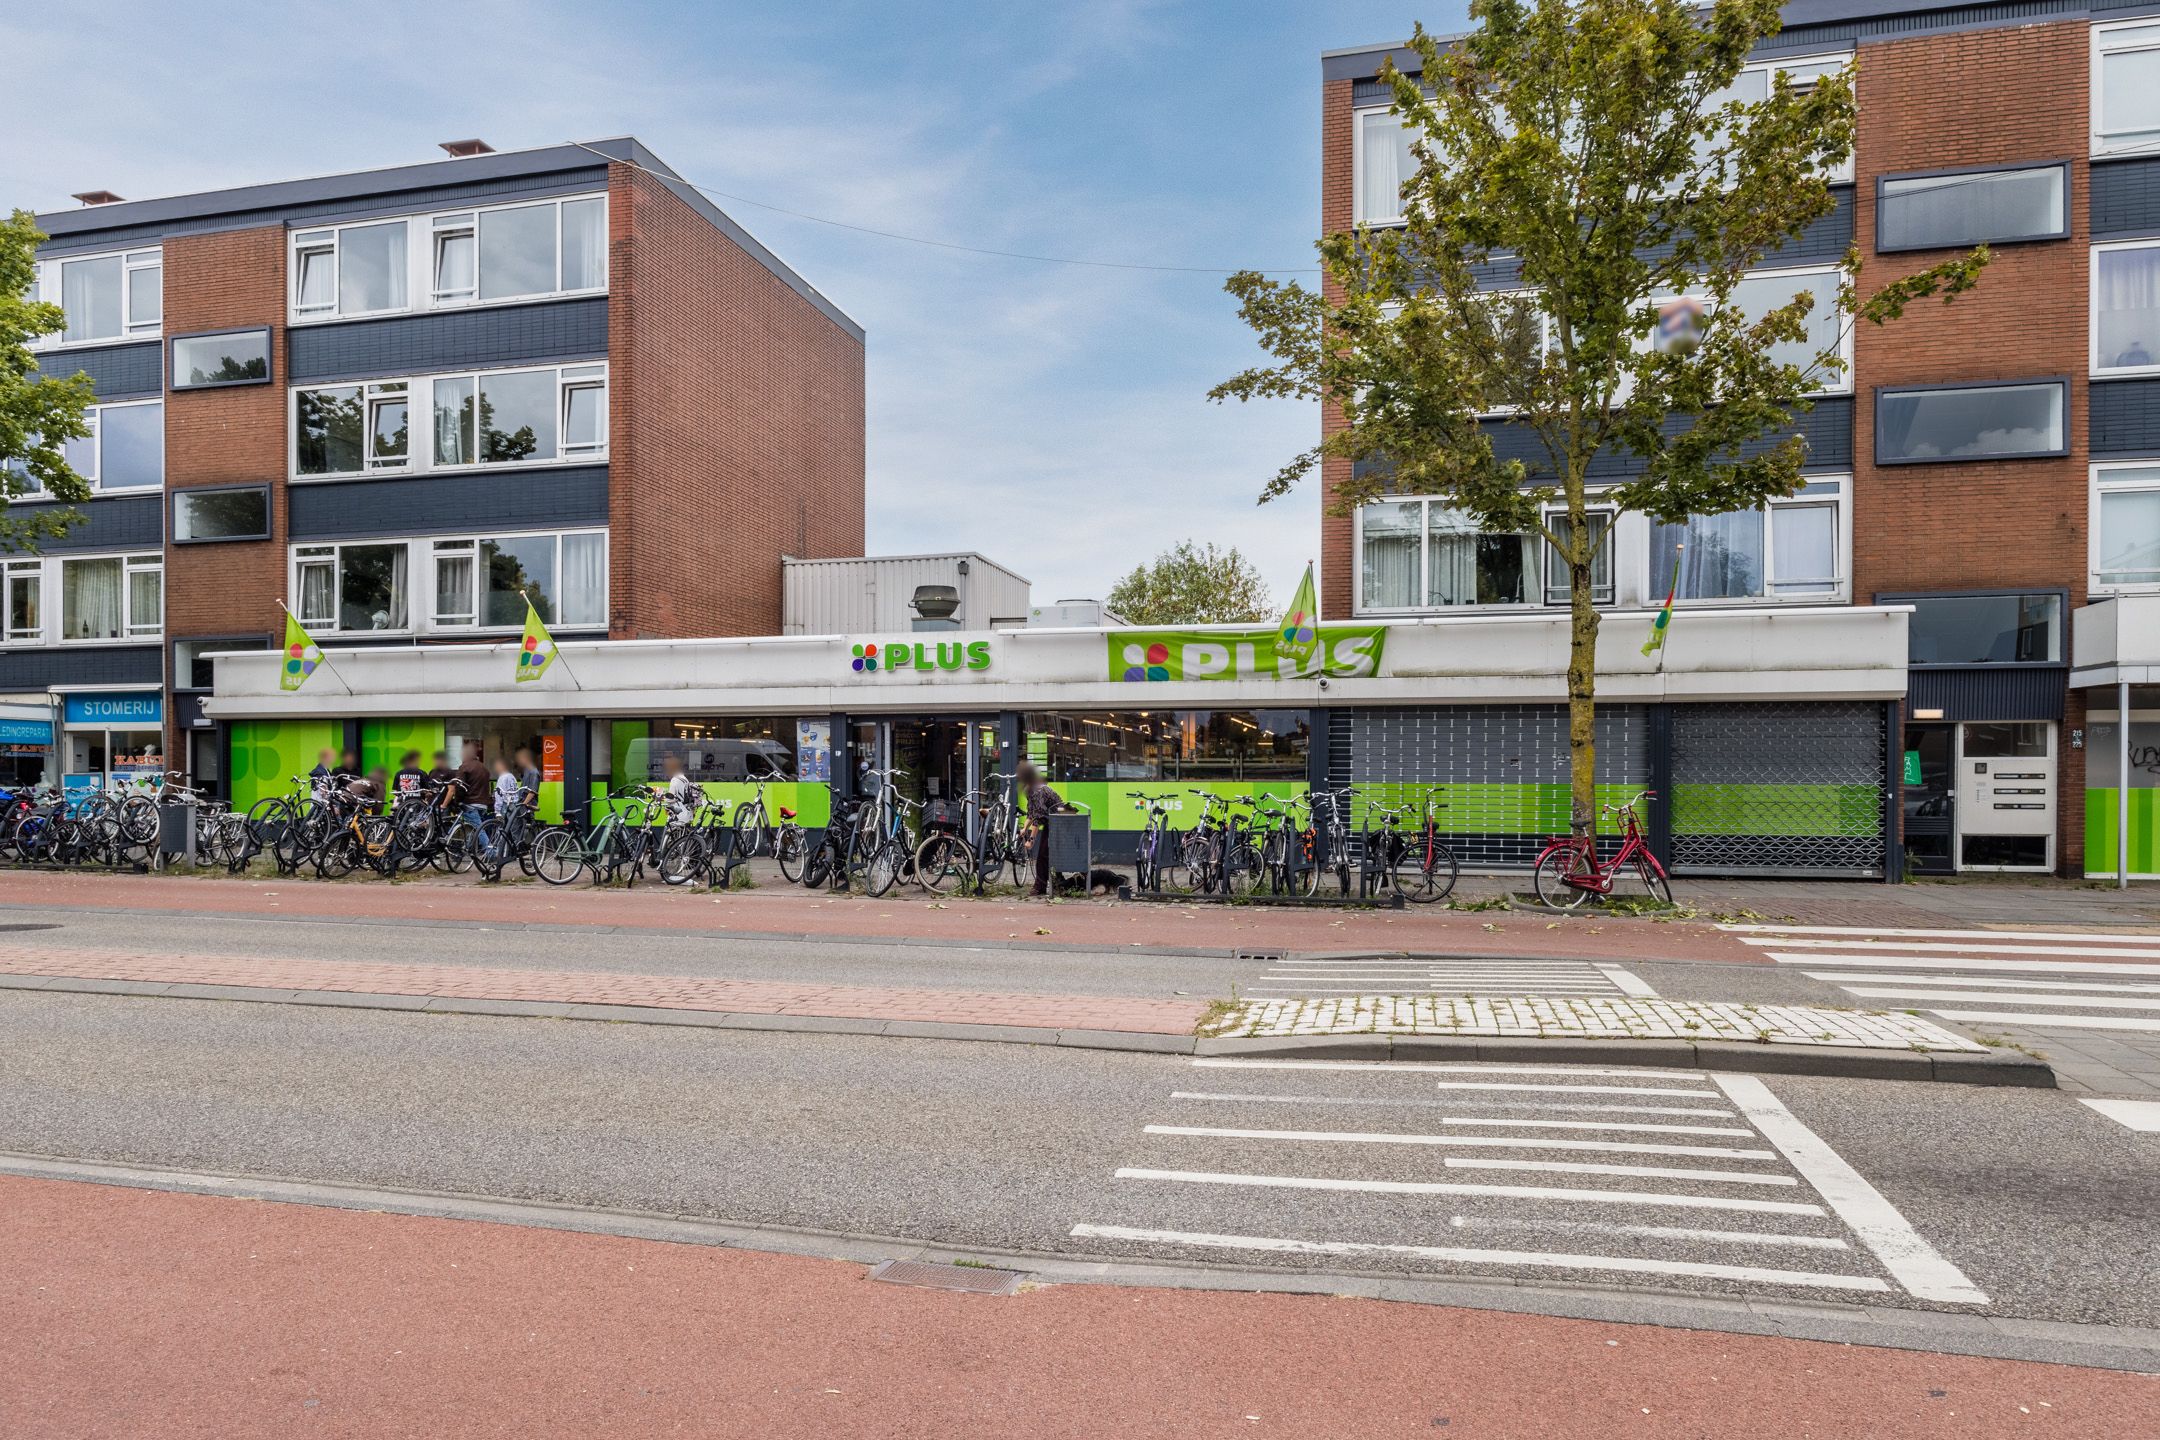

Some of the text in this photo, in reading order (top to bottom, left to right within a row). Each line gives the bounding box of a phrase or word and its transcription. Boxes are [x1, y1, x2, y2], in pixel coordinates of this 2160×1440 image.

[884, 641, 992, 672] PLUS
[1182, 637, 1375, 681] PLUS
[84, 701, 154, 716] STOMERIJ
